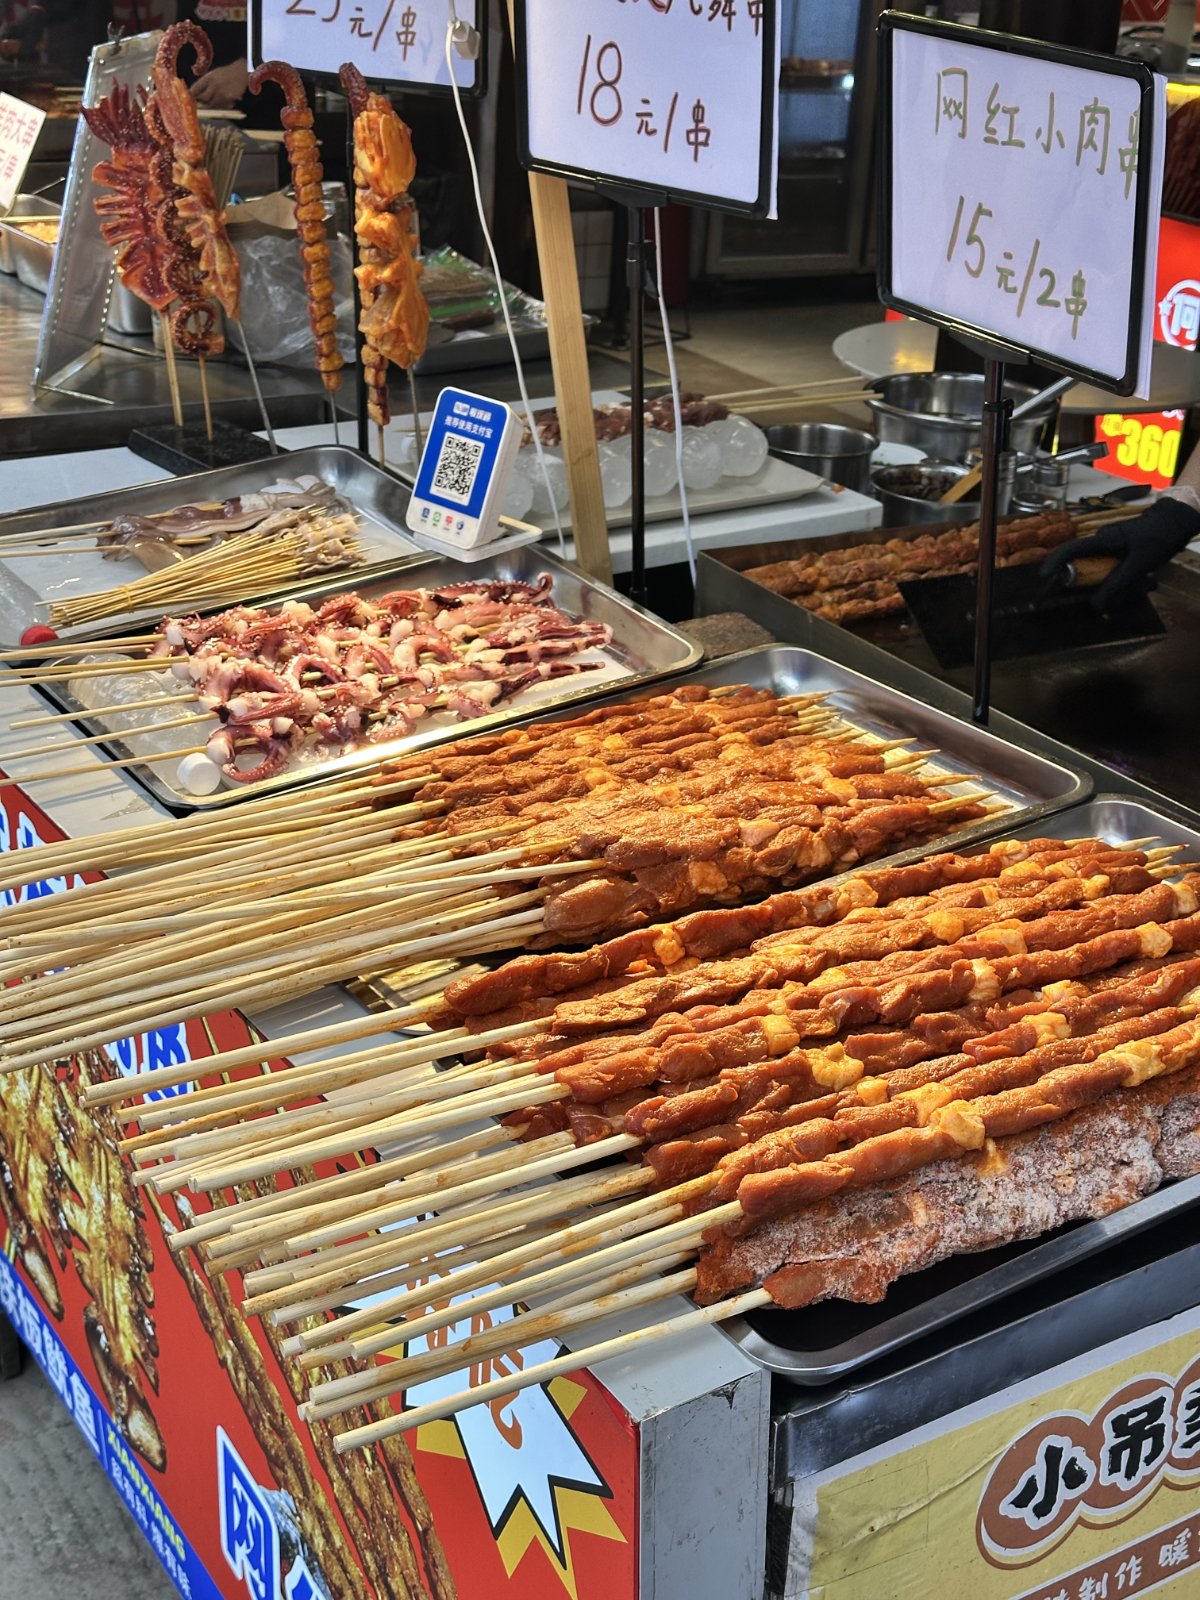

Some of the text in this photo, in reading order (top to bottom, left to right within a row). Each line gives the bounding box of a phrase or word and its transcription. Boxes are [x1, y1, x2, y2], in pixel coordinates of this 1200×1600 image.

[286, 0, 417, 61] 元/串
[577, 34, 711, 163] 18元/串
[935, 67, 1140, 200] 网红小肉串
[947, 195, 1088, 340] 15元/2串
